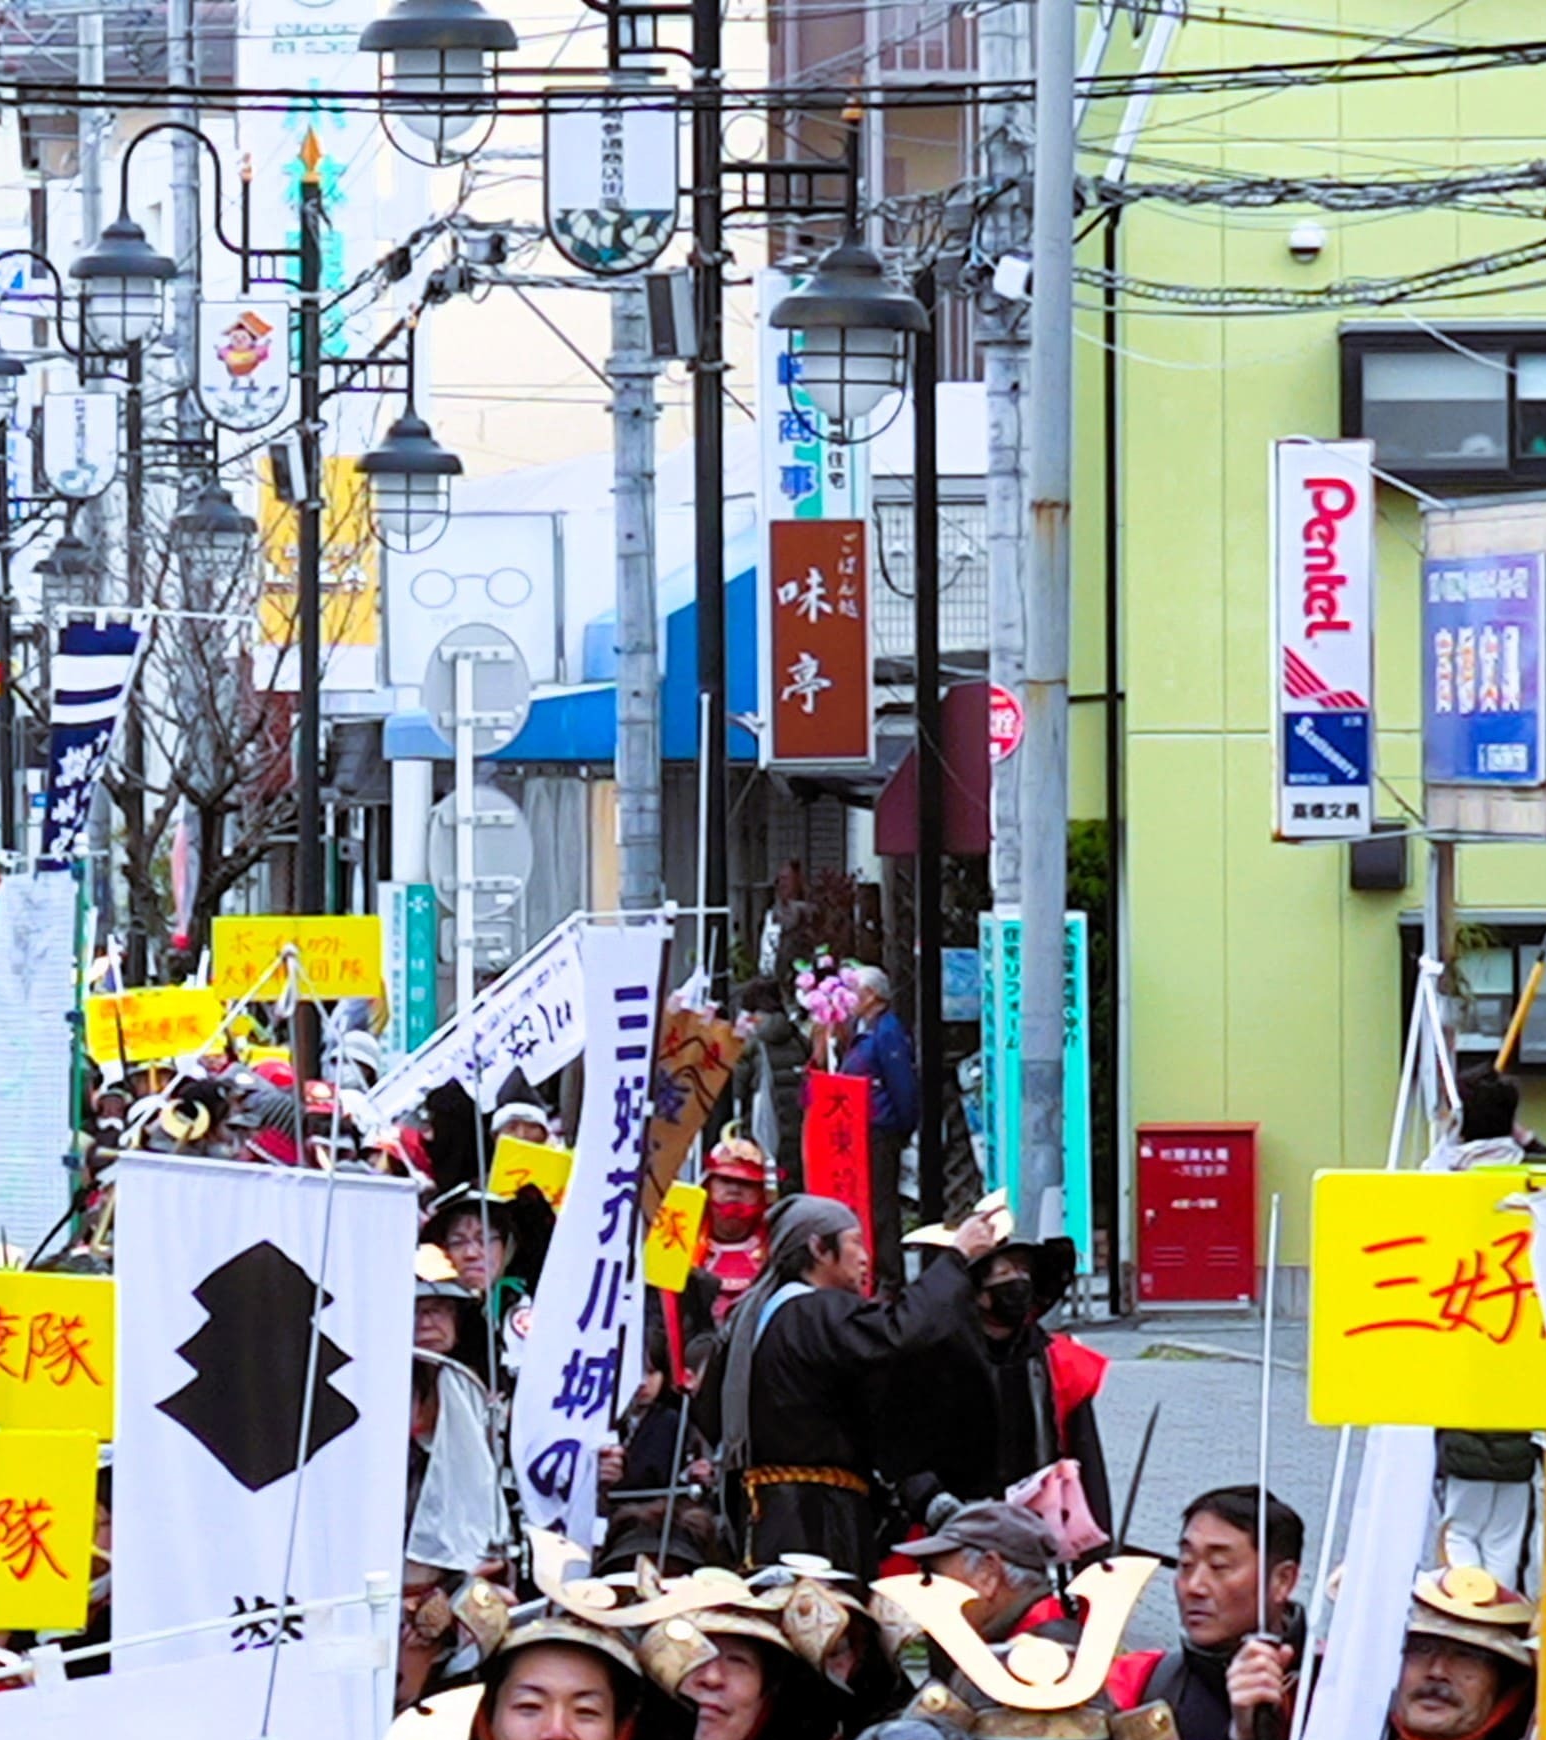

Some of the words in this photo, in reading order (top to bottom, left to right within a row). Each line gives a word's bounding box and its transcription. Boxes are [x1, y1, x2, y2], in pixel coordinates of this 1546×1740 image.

[775, 565, 835, 715] 味亭
[1302, 477, 1358, 640] Pentel
[525, 983, 651, 1534] 三好芥川城の
